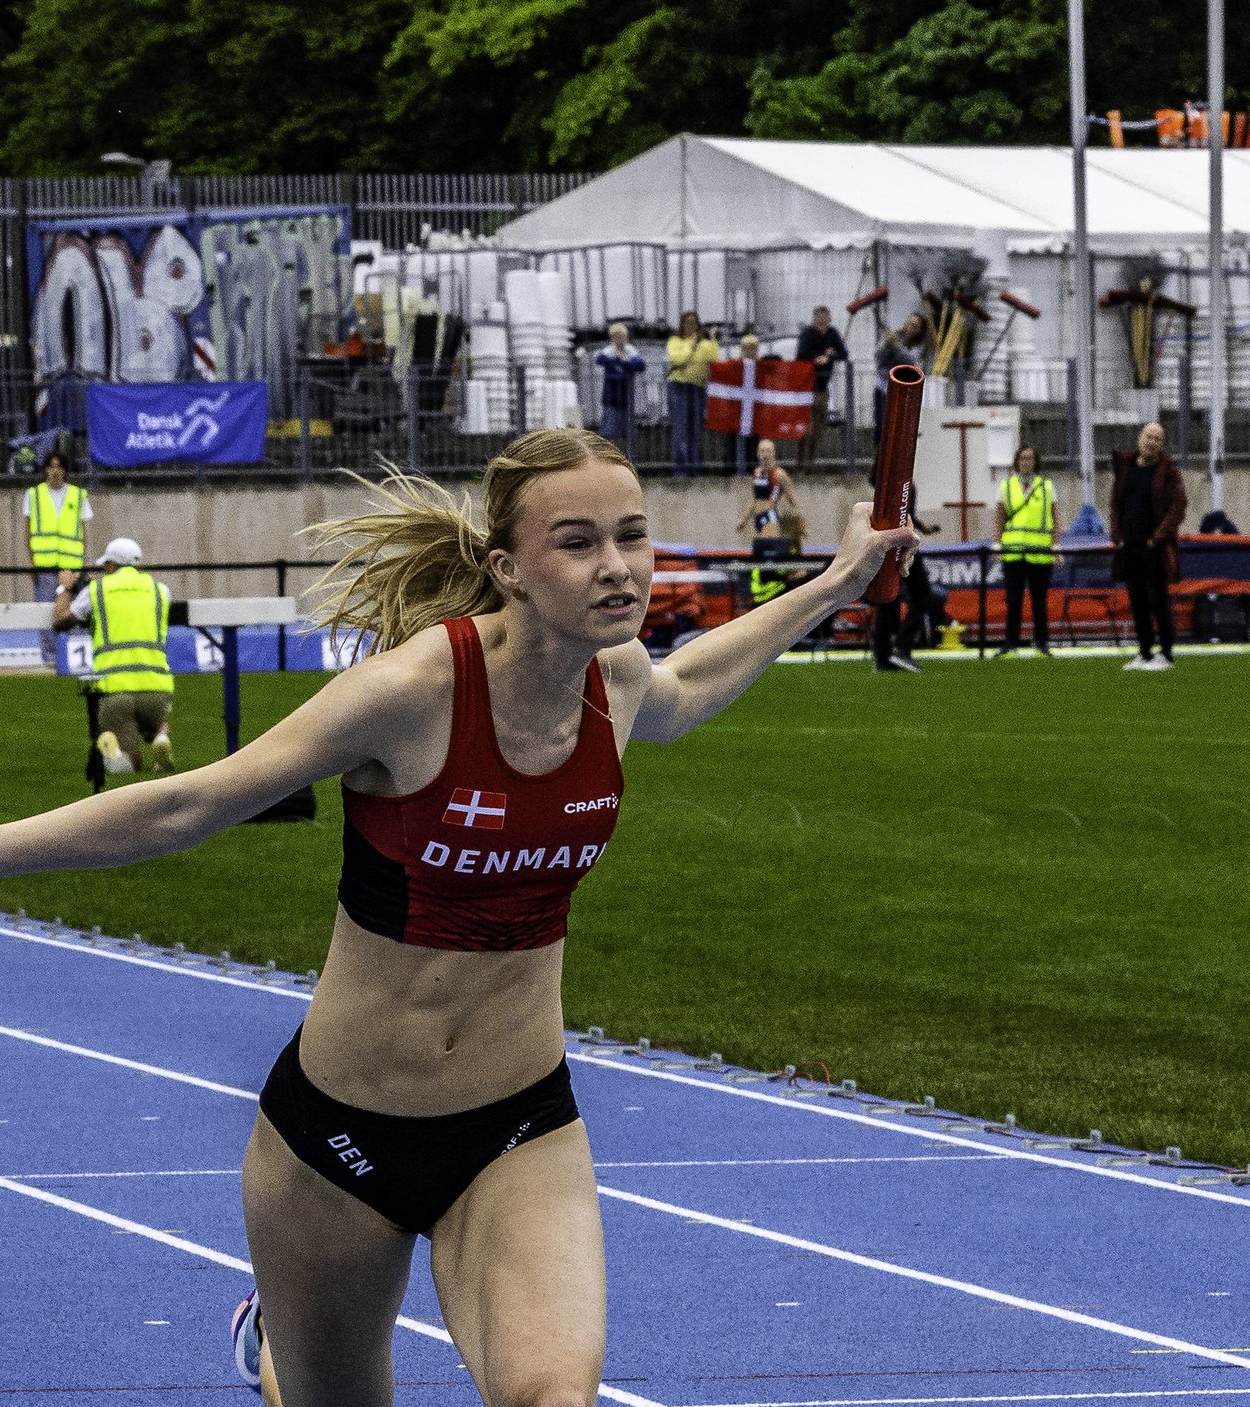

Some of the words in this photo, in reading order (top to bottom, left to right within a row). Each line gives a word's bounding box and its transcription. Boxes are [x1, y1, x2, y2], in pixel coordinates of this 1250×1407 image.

[564, 796, 612, 814] CRAFT
[421, 841, 608, 875] DENMAR
[327, 1133, 374, 1177] DEN
